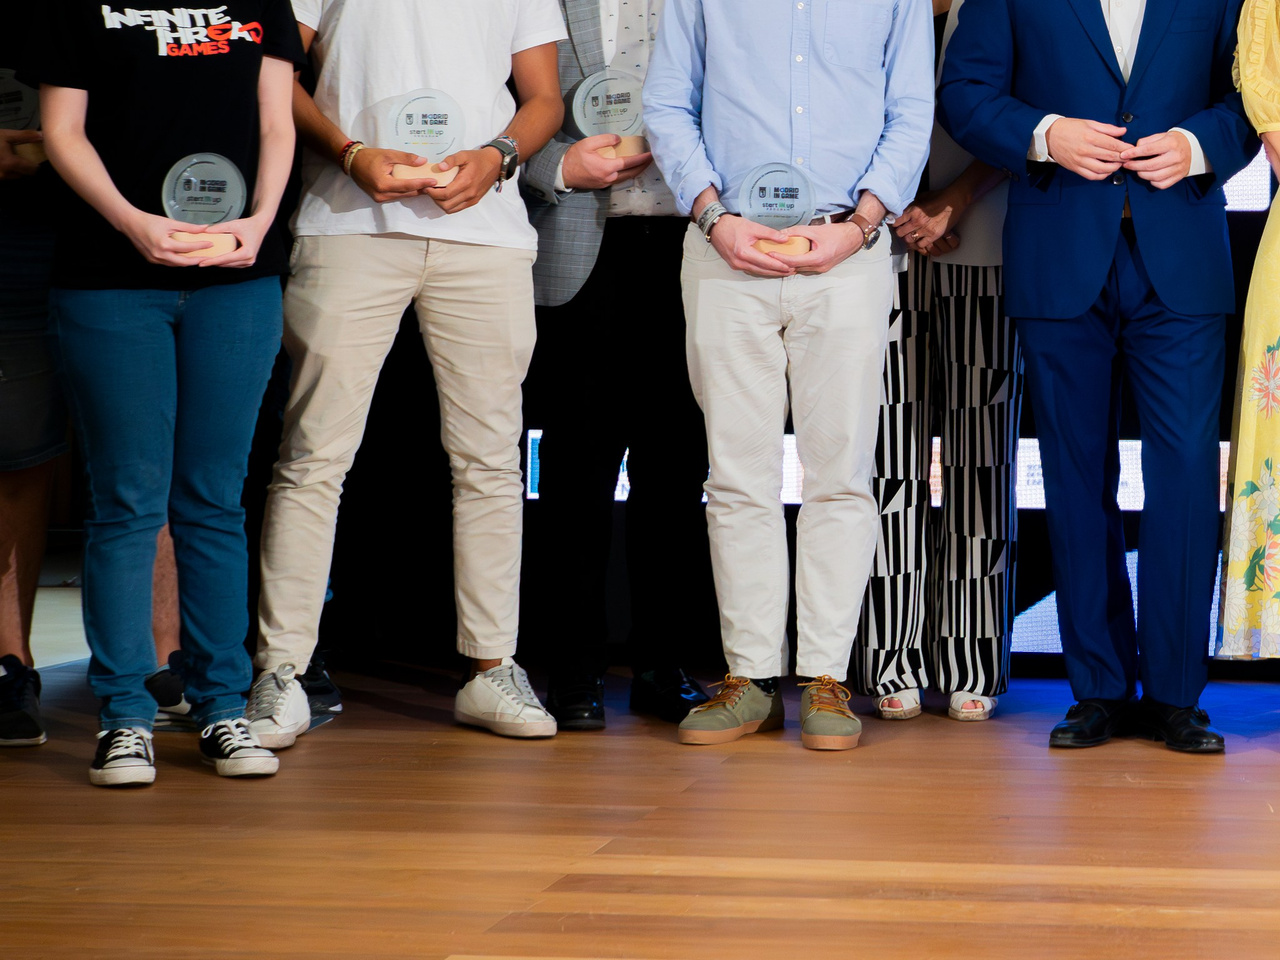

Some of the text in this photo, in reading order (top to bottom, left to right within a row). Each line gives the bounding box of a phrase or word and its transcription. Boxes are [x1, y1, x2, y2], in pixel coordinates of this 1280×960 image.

[101, 4, 231, 29] INFINITE
[145, 21, 264, 56] THREAD
[167, 40, 231, 57] GAMES
